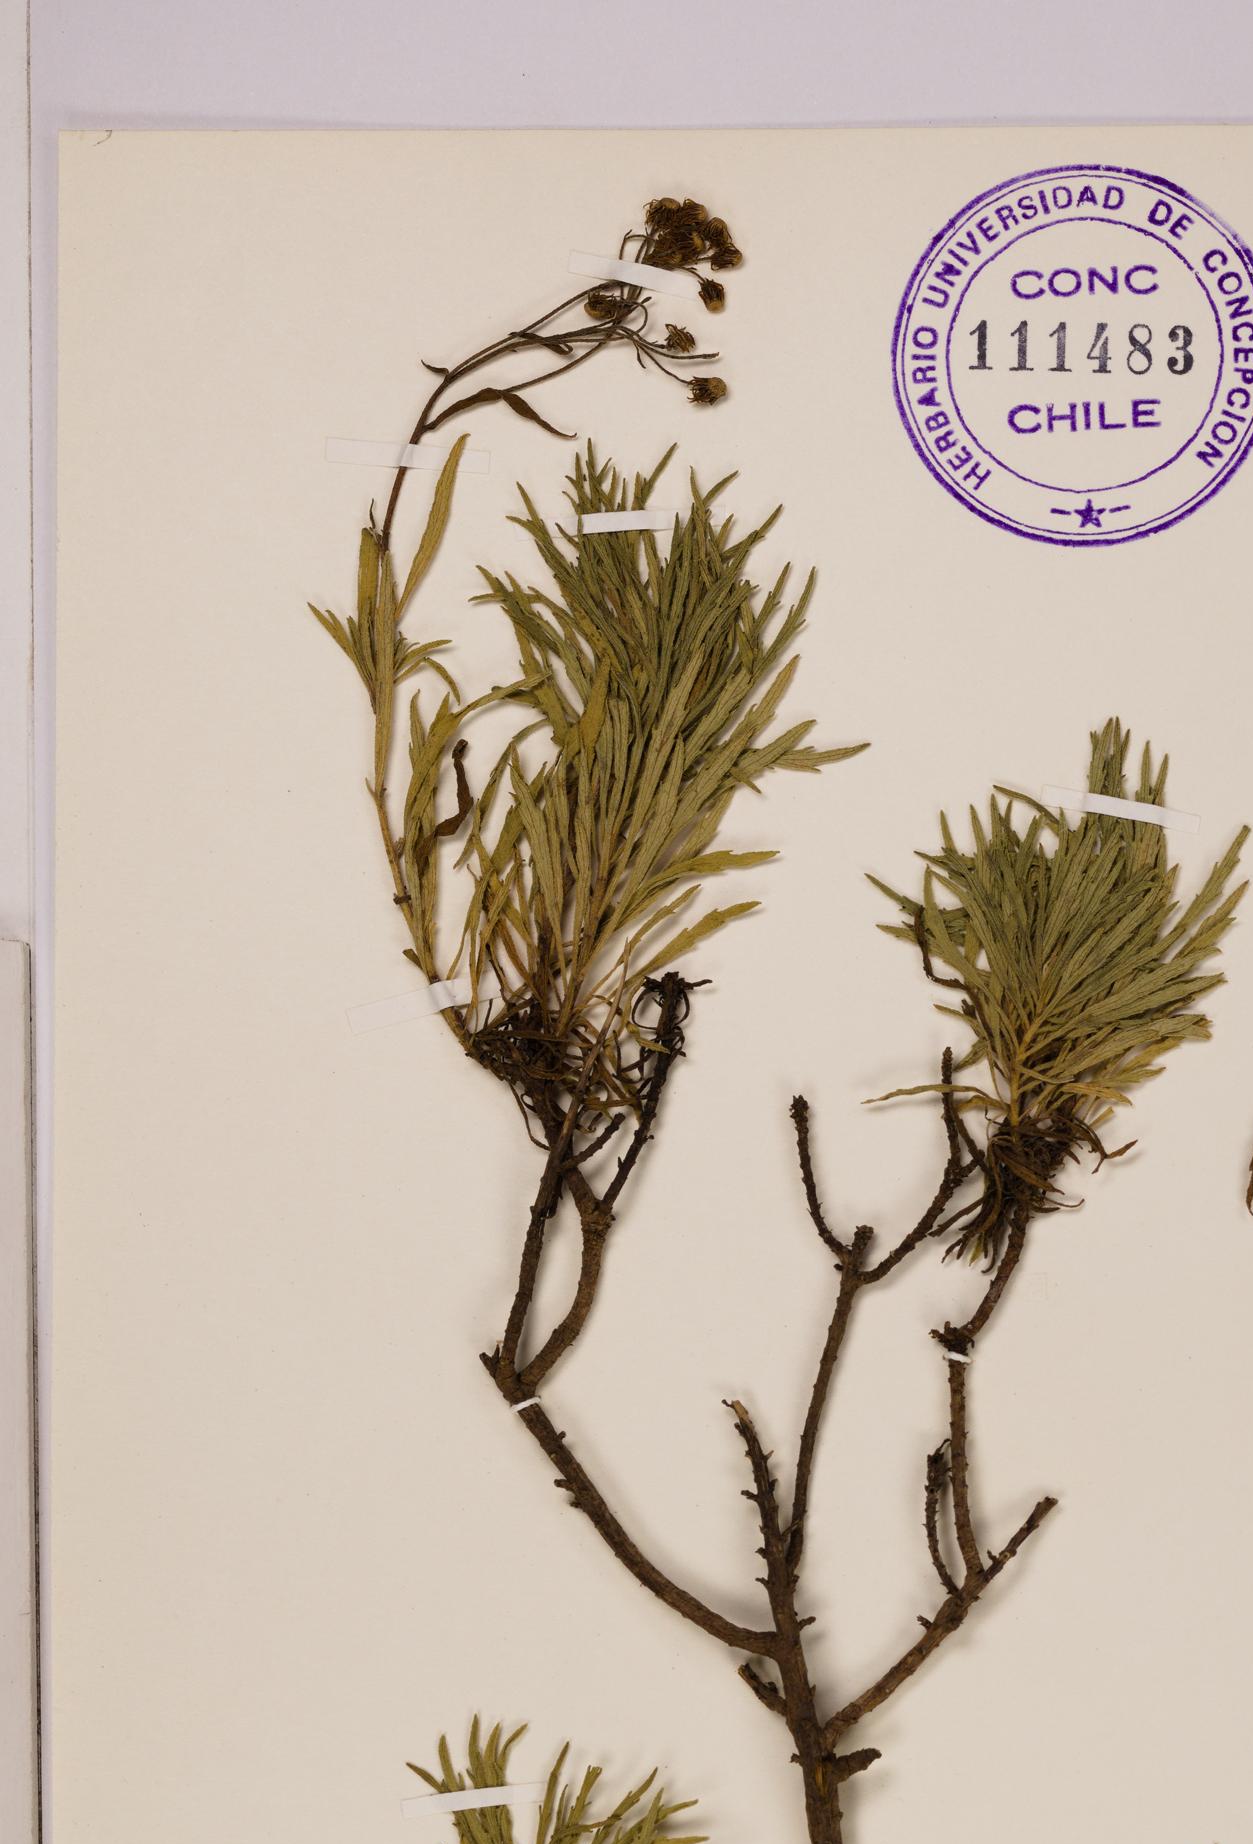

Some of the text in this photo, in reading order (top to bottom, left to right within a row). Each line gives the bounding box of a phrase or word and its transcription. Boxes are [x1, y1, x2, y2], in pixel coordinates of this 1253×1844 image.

[1148, 198, 1196, 241] DE
[922, 185, 1126, 310] UNIVERSIDAD
[1010, 264, 1159, 300] CONC
[968, 319, 1195, 376] 111483
[912, 325, 992, 491] HERBARIO
[1007, 398, 1161, 435] CHILE
